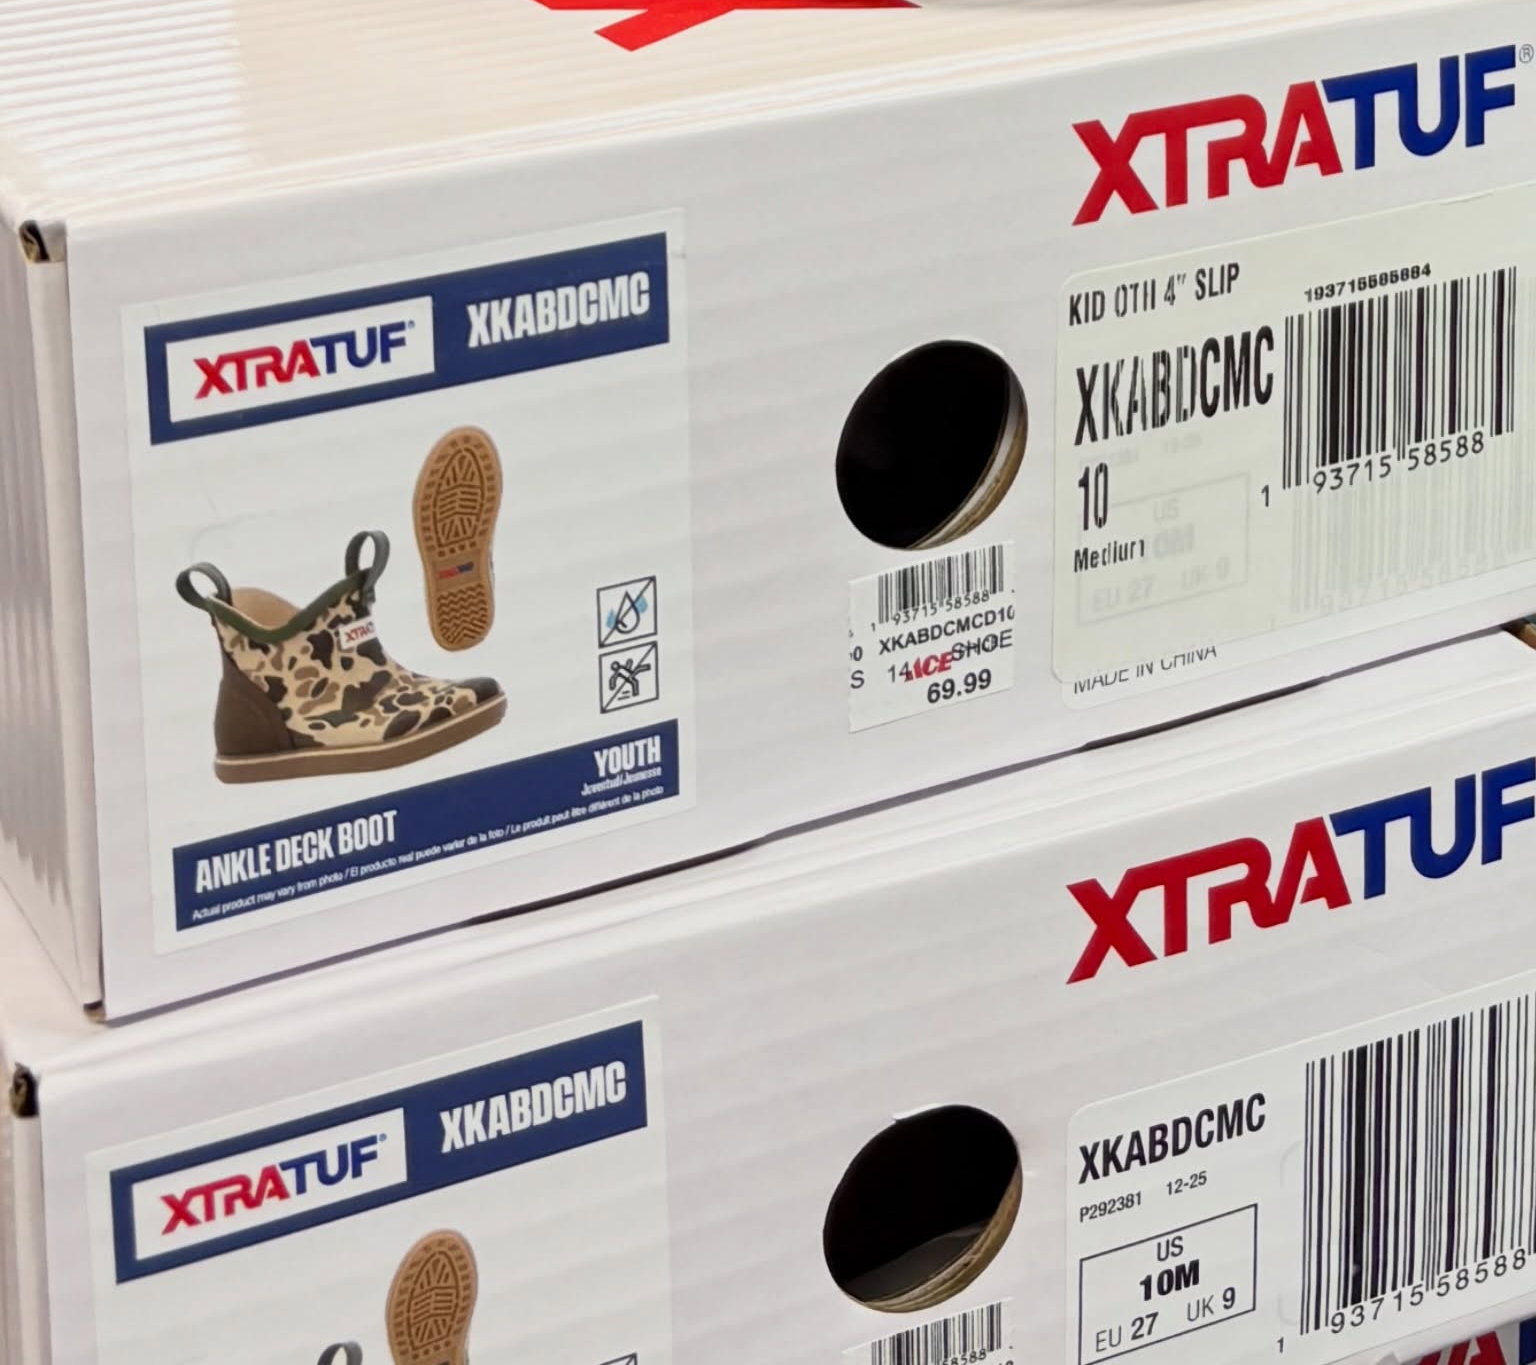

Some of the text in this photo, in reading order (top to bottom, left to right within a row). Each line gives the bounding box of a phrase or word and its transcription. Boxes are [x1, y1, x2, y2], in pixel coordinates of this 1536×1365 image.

[467, 270, 651, 349] XKABDCMC
[1069, 290, 1106, 326] KID
[1195, 262, 1240, 301] SLIP
[1074, 325, 1274, 446] XKABDCMC
[1313, 455, 1392, 494] 93715
[1408, 431, 1484, 471] 58588
[1078, 462, 1109, 531] 10
[945, 590, 991, 612] 58588
[927, 668, 992, 704] 69.99
[593, 735, 661, 777] YOUTH
[195, 810, 397, 893] ANKLE DECK BOOT
[221, 895, 256, 914] product
[257, 888, 276, 903] may
[276, 883, 296, 899] vary
[297, 877, 318, 891] from
[318, 871, 344, 888] photo
[360, 857, 397, 876] producto
[415, 844, 442, 861] puede
[440, 1059, 627, 1156] XKABDCMC
[1078, 1092, 1266, 1184] XKABDCMC
[1080, 1170, 1207, 1223] P292381 12-25
[1139, 1259, 1200, 1301] 10M
[1156, 1236, 1184, 1261] US
[1096, 1286, 1236, 1352] EU 27 UK 9
[1277, 1337, 1284, 1353] 1
[1330, 1284, 1425, 1334] 93715
[1435, 1248, 1527, 1298] 58588
